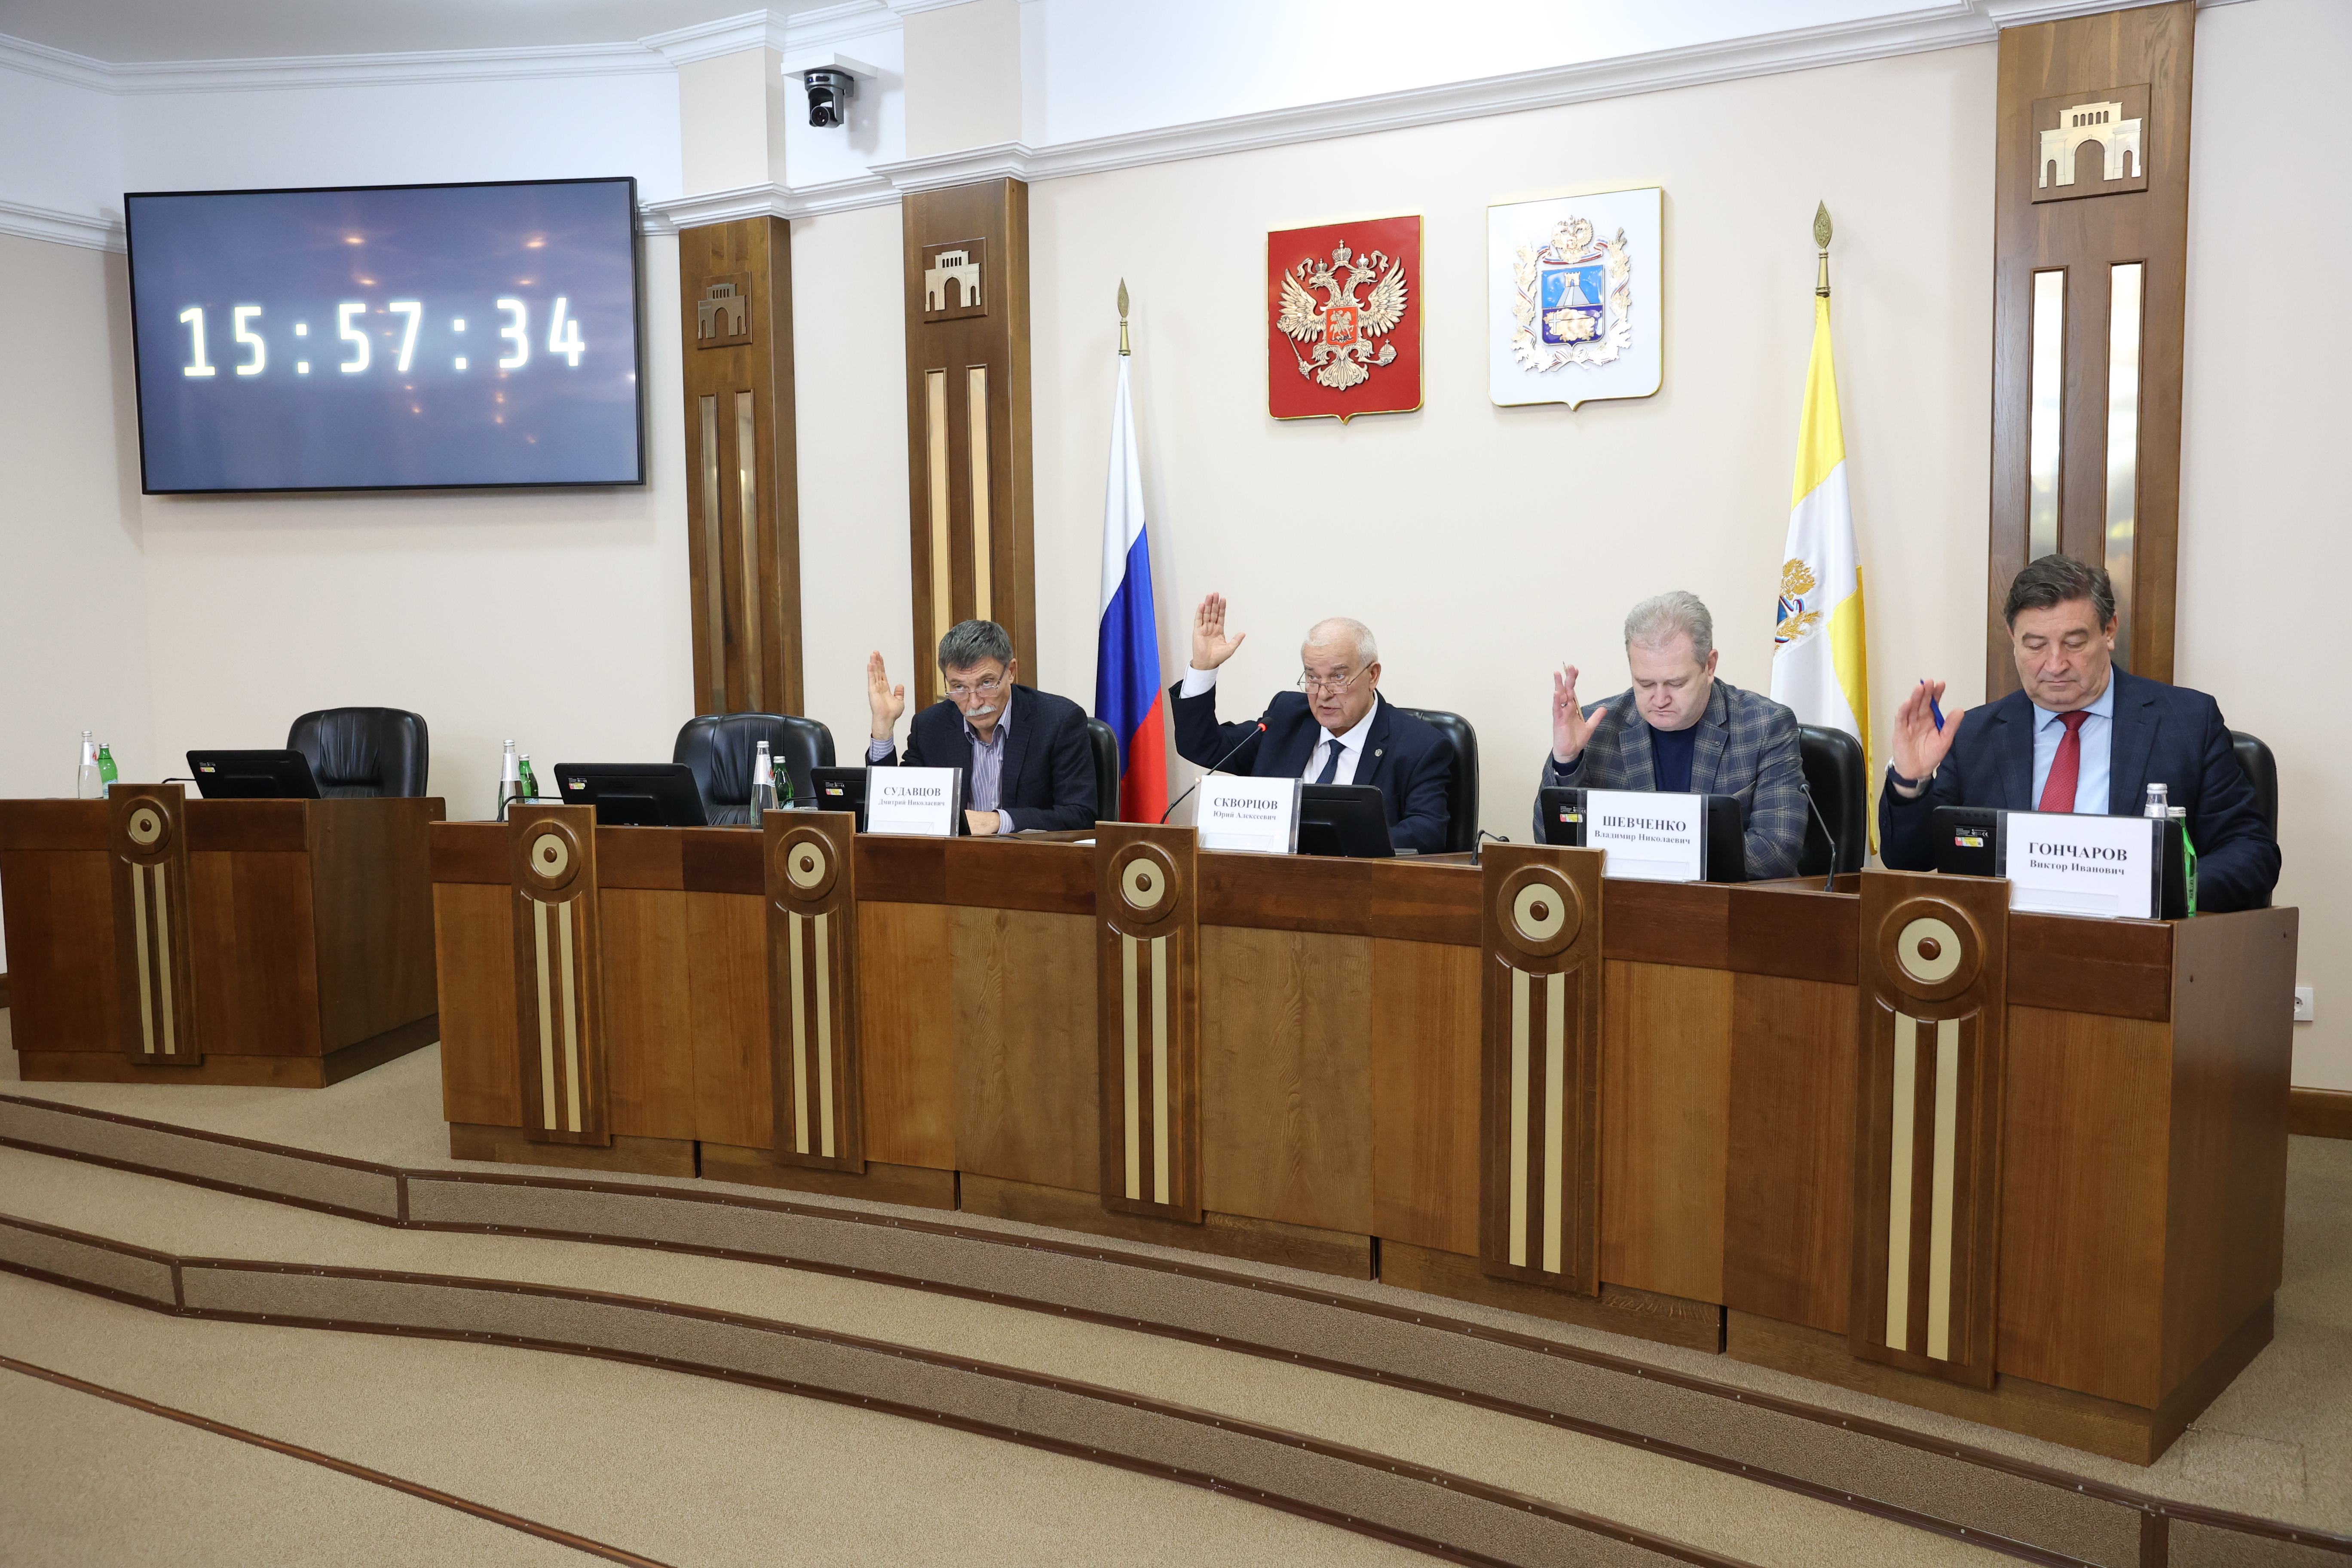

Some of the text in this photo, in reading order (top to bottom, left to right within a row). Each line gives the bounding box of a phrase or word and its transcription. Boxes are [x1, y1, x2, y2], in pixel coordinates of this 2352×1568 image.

[180, 297, 585, 377] 15:57:34
[884, 787, 941, 797] СУДАВЦОВ
[1214, 797, 1278, 811] СКВОРЦОВ
[1213, 811, 1276, 821] Юрий Алексеевич
[1603, 816, 1686, 832] ШЕВЧЕНКО
[1595, 830, 1690, 845] Владимир Николаевич
[2028, 842, 2127, 861] ГОНЧАРОВ
[2030, 859, 2125, 875] Виктор Иванович
